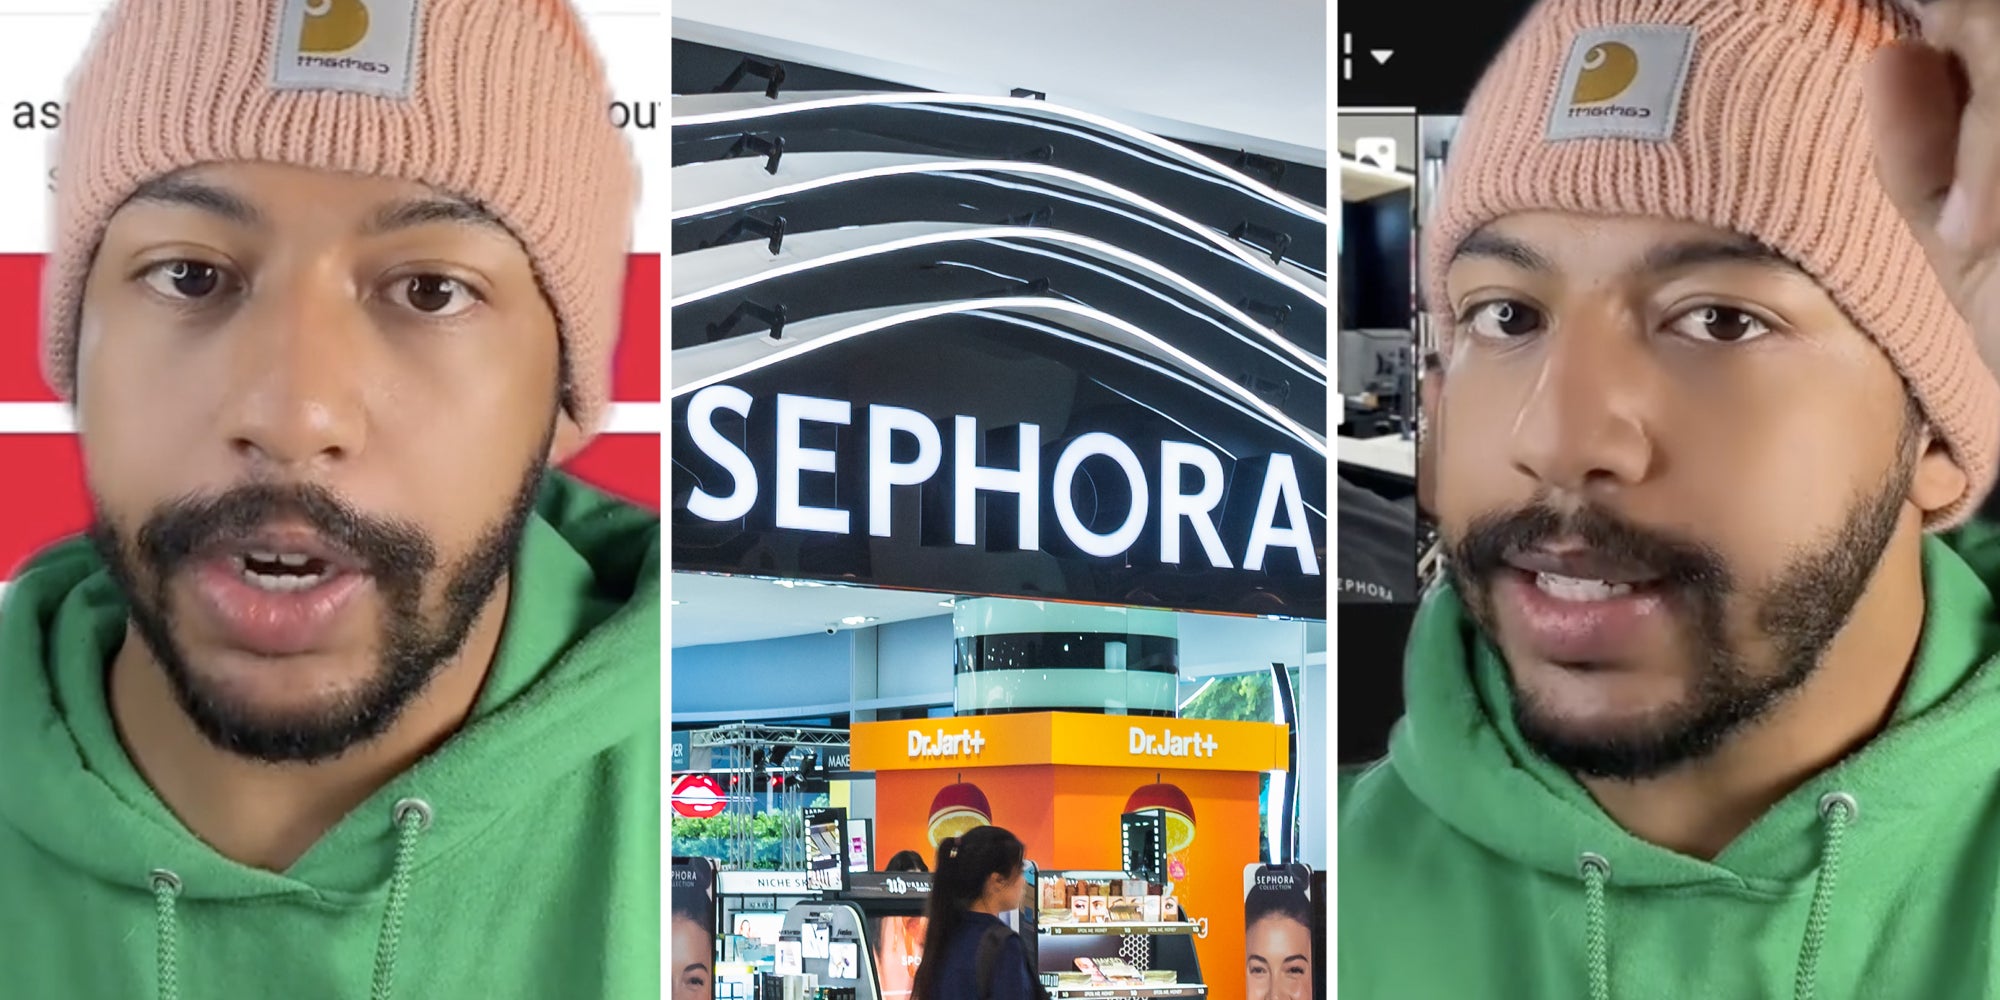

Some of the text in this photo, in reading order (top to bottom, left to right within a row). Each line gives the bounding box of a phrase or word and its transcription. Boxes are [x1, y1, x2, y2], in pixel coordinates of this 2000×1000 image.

[608, 101, 661, 129] ou
[686, 384, 1320, 576] SEPHORA
[908, 728, 985, 756] Dr.Jart+
[1129, 726, 1218, 757] Dr.Jart+
[828, 754, 850, 767] MAKE
[757, 878, 791, 887] NICHE
[1257, 875, 1294, 884] SEPHORA
